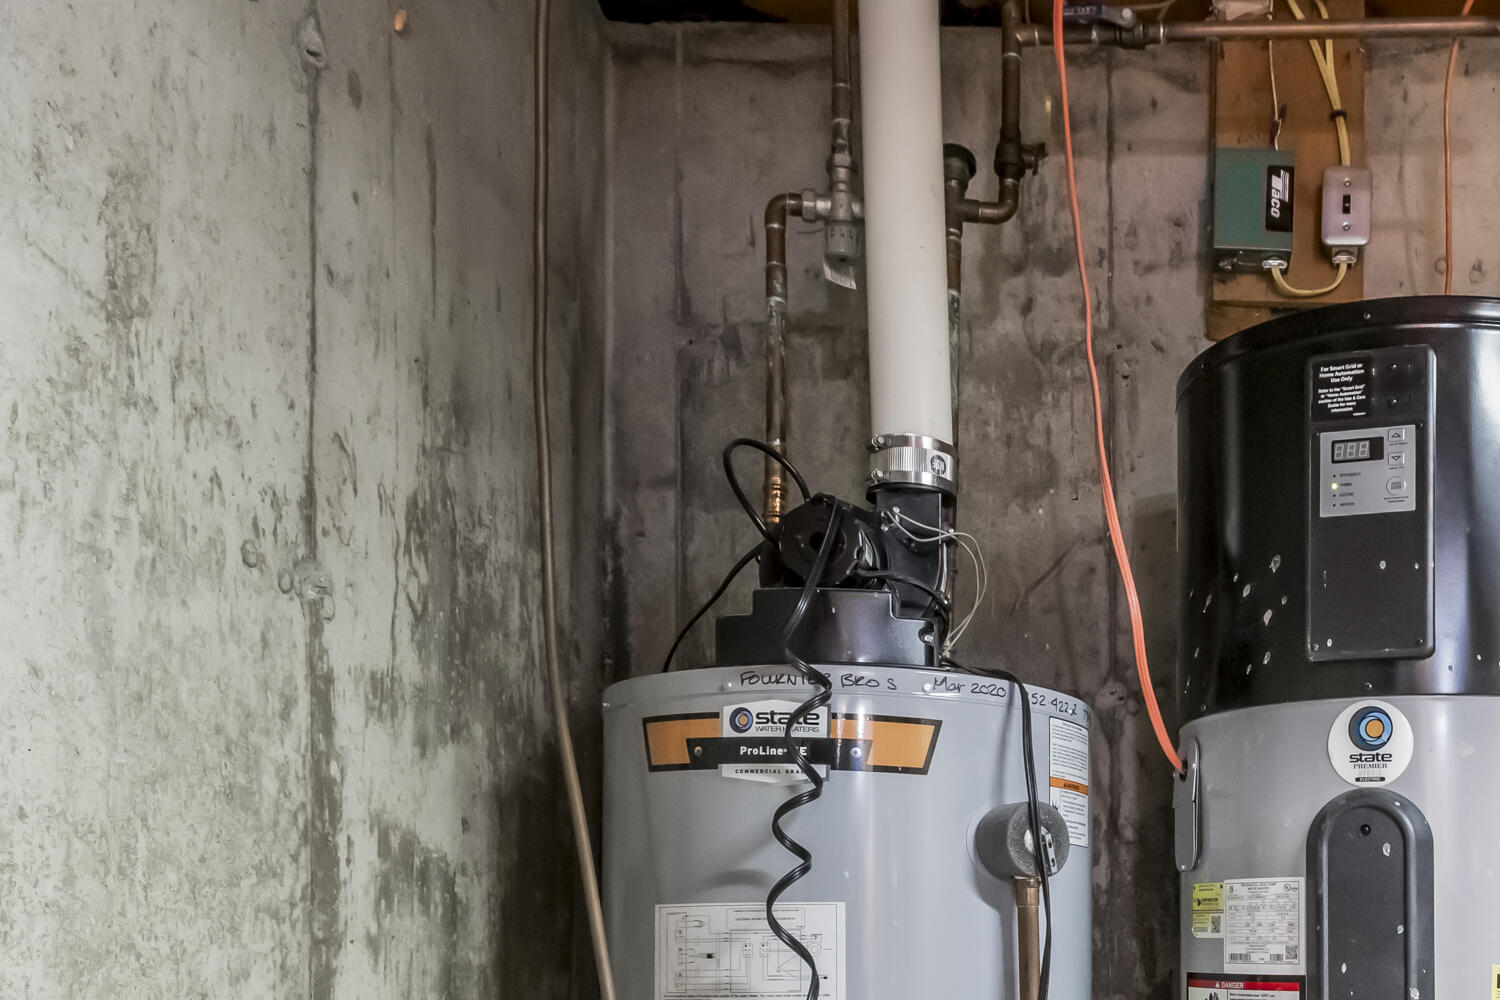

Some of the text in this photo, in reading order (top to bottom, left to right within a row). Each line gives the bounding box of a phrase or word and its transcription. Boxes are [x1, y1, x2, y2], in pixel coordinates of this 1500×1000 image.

[740, 671, 832, 686] FOURNI
[933, 676, 966, 692] Mar
[970, 683, 1006, 698] 2020
[1349, 752, 1392, 763] state
